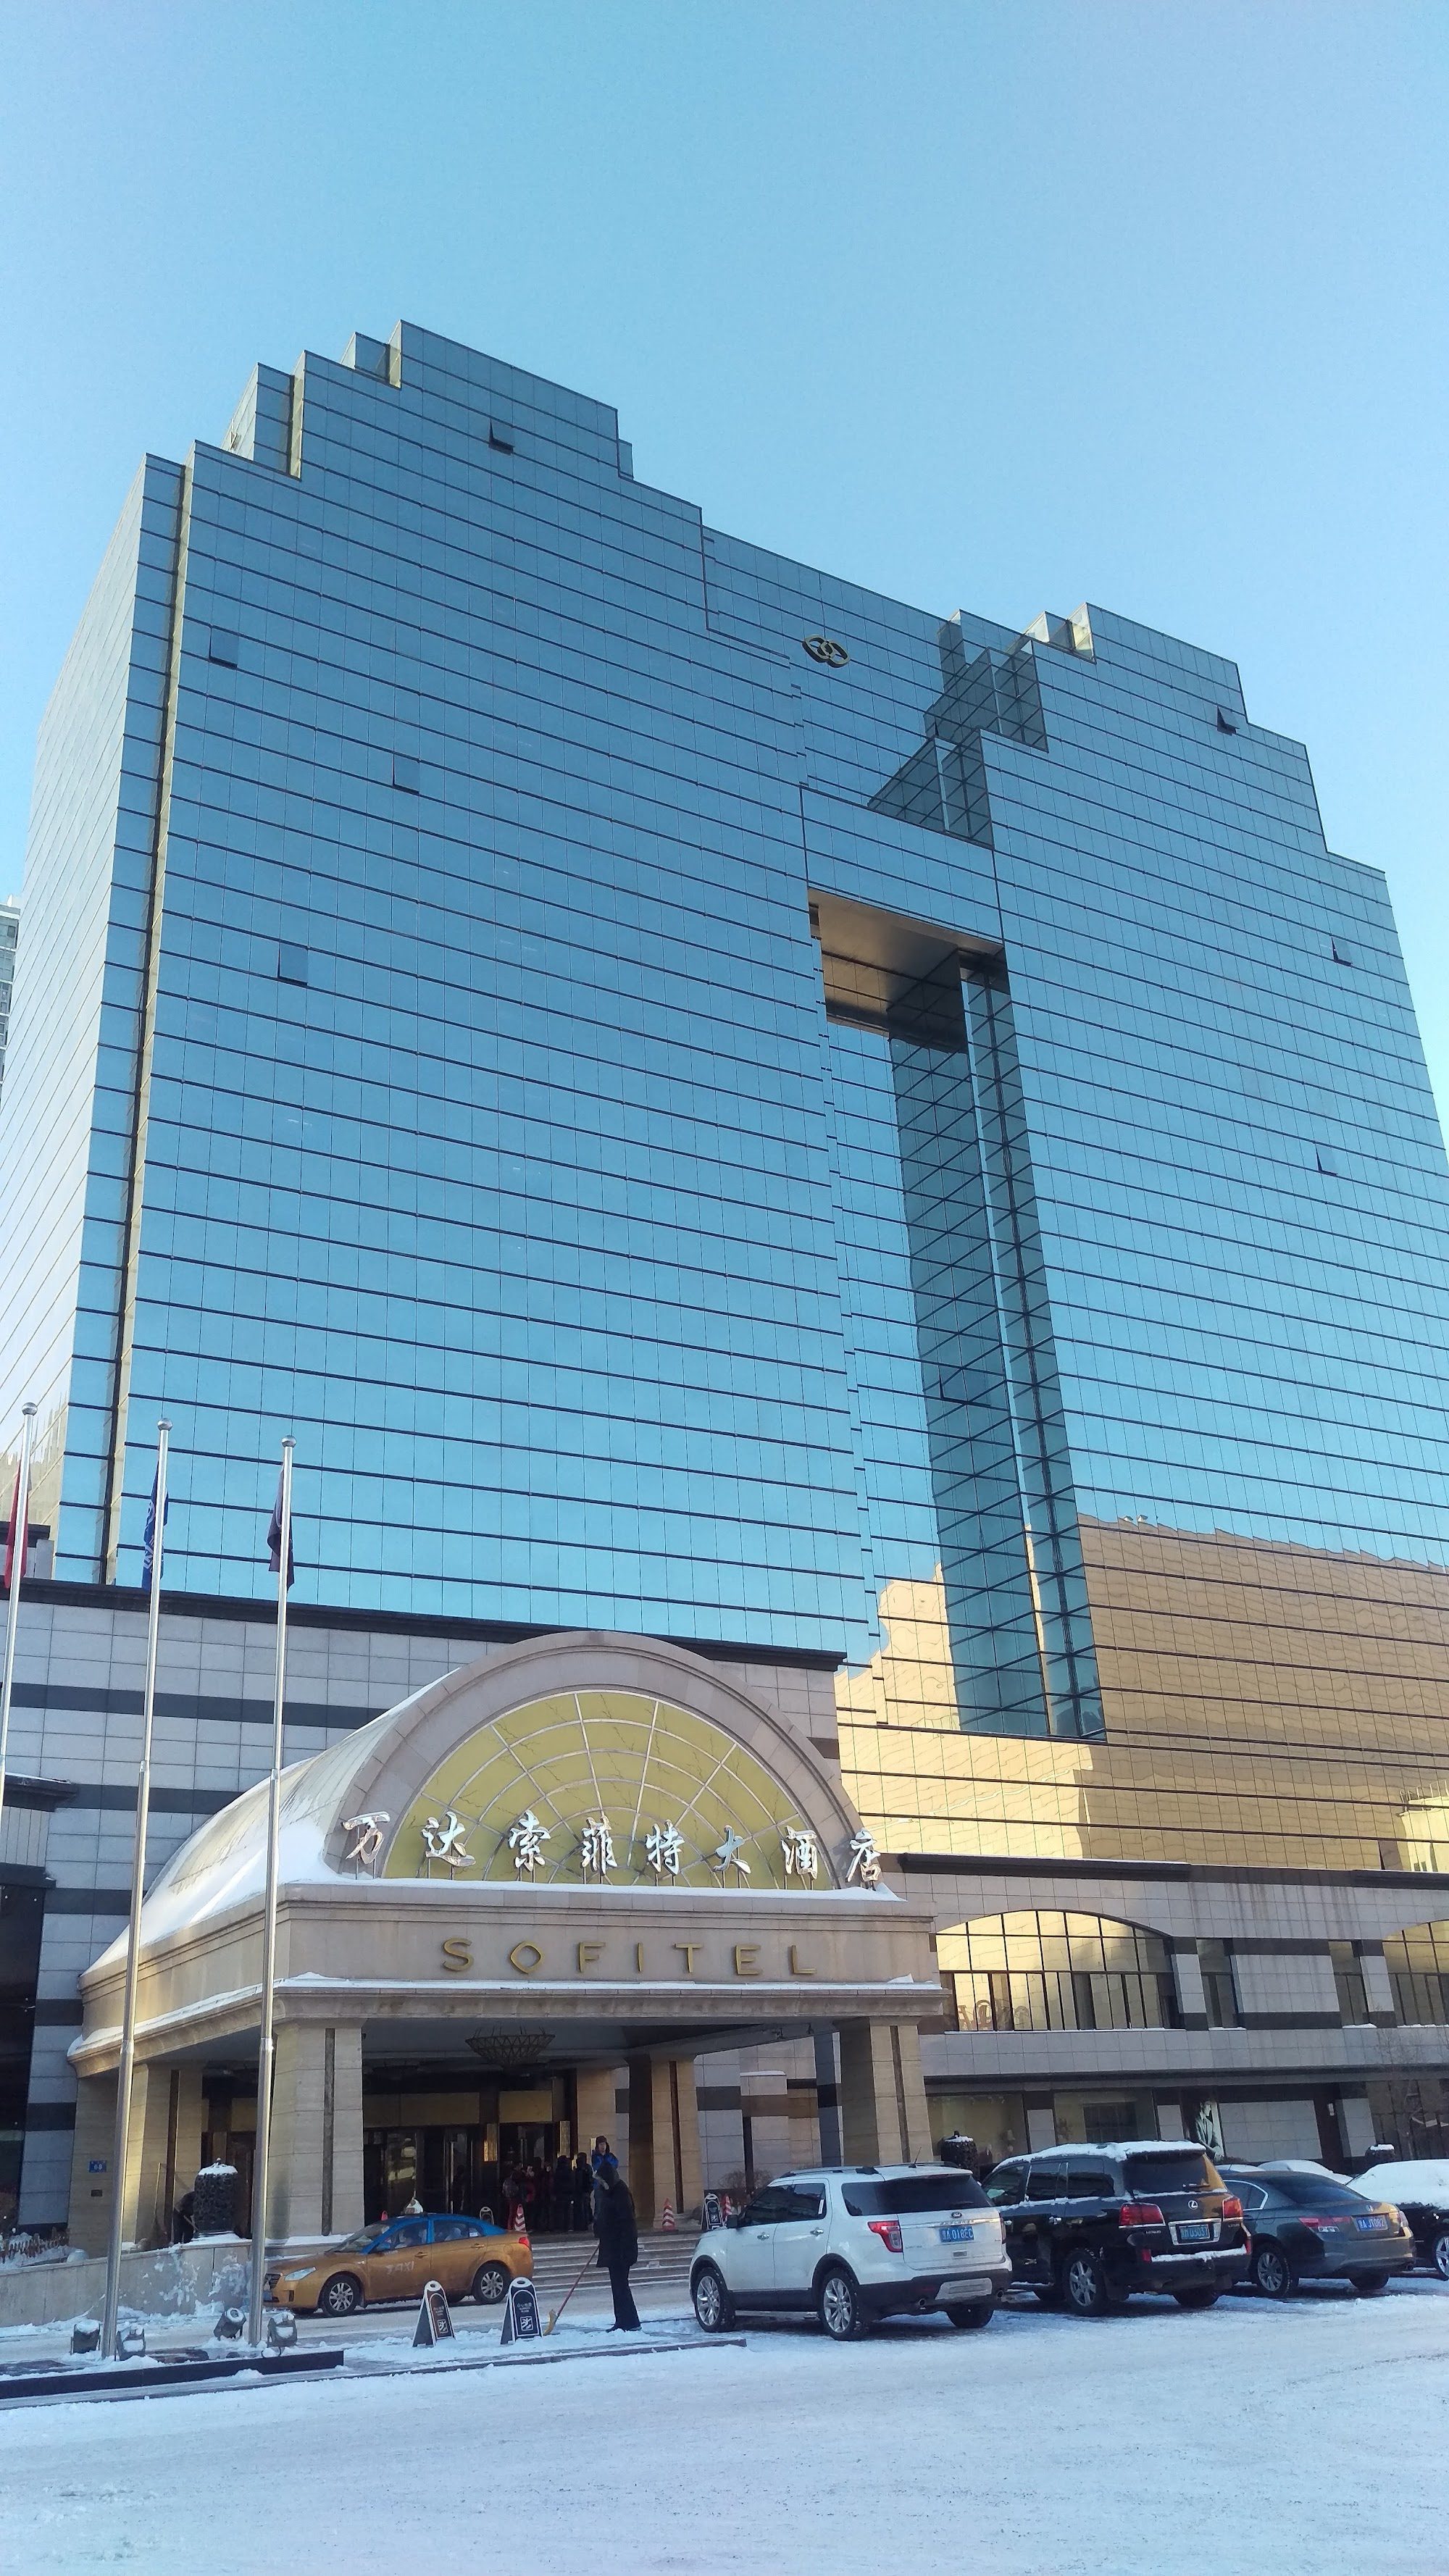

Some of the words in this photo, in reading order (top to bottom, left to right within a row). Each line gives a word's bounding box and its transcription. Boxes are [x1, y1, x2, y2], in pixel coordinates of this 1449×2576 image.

[341, 1809, 881, 1882] 万达索菲特大酒店
[443, 1937, 817, 1975] SOFITEL
